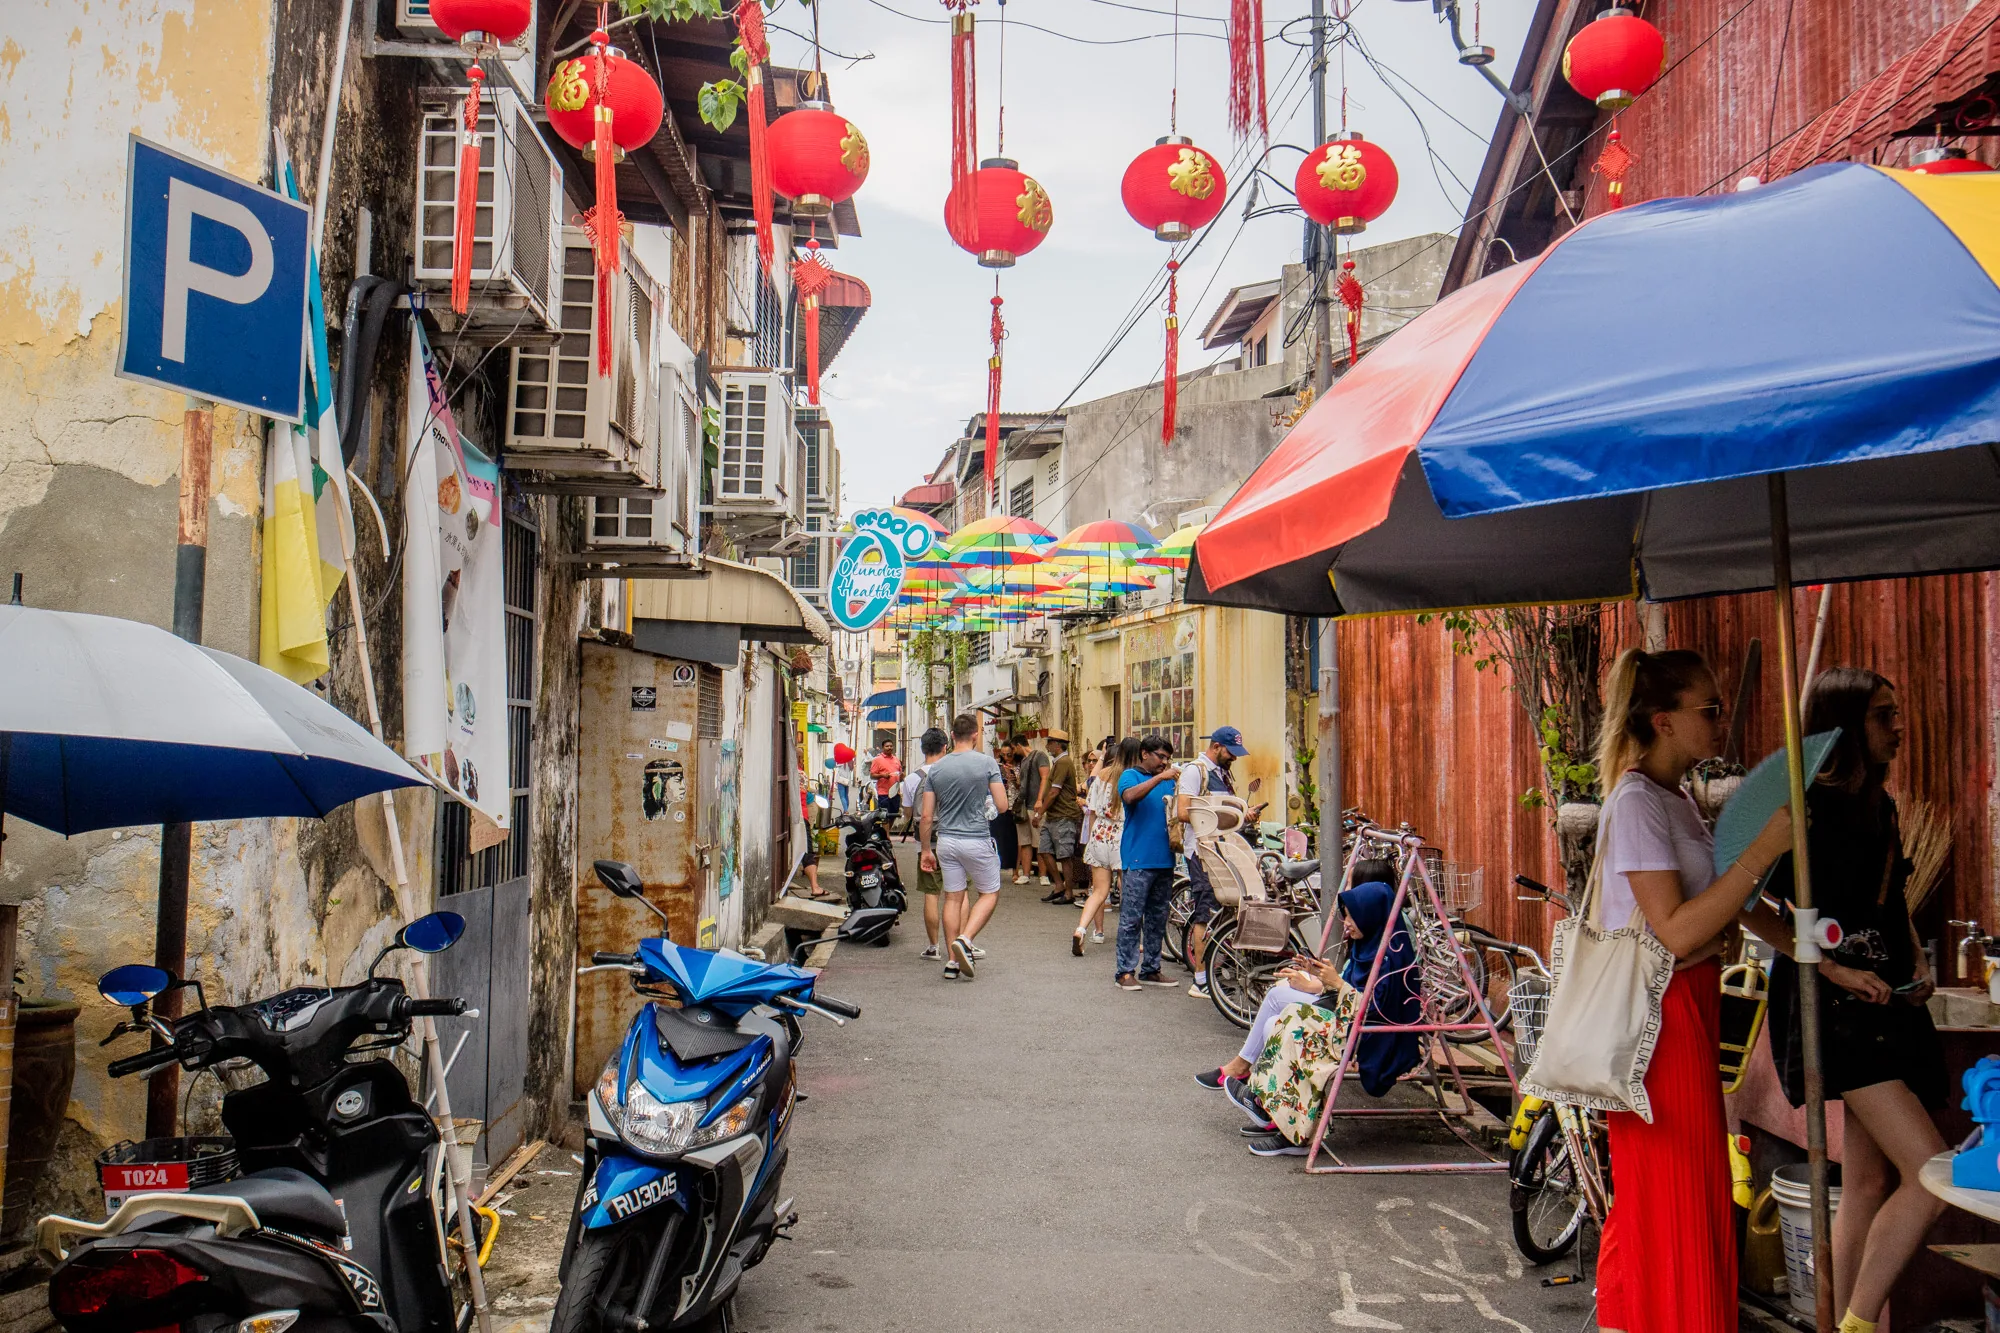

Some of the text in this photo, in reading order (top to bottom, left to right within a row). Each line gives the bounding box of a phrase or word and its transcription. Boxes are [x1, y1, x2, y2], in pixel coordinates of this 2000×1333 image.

[1168, 148, 1216, 200] 福
[1316, 145, 1367, 191] 福
[161, 176, 275, 364] P
[837, 577, 894, 600] Health
[611, 1171, 678, 1219] RU3045
